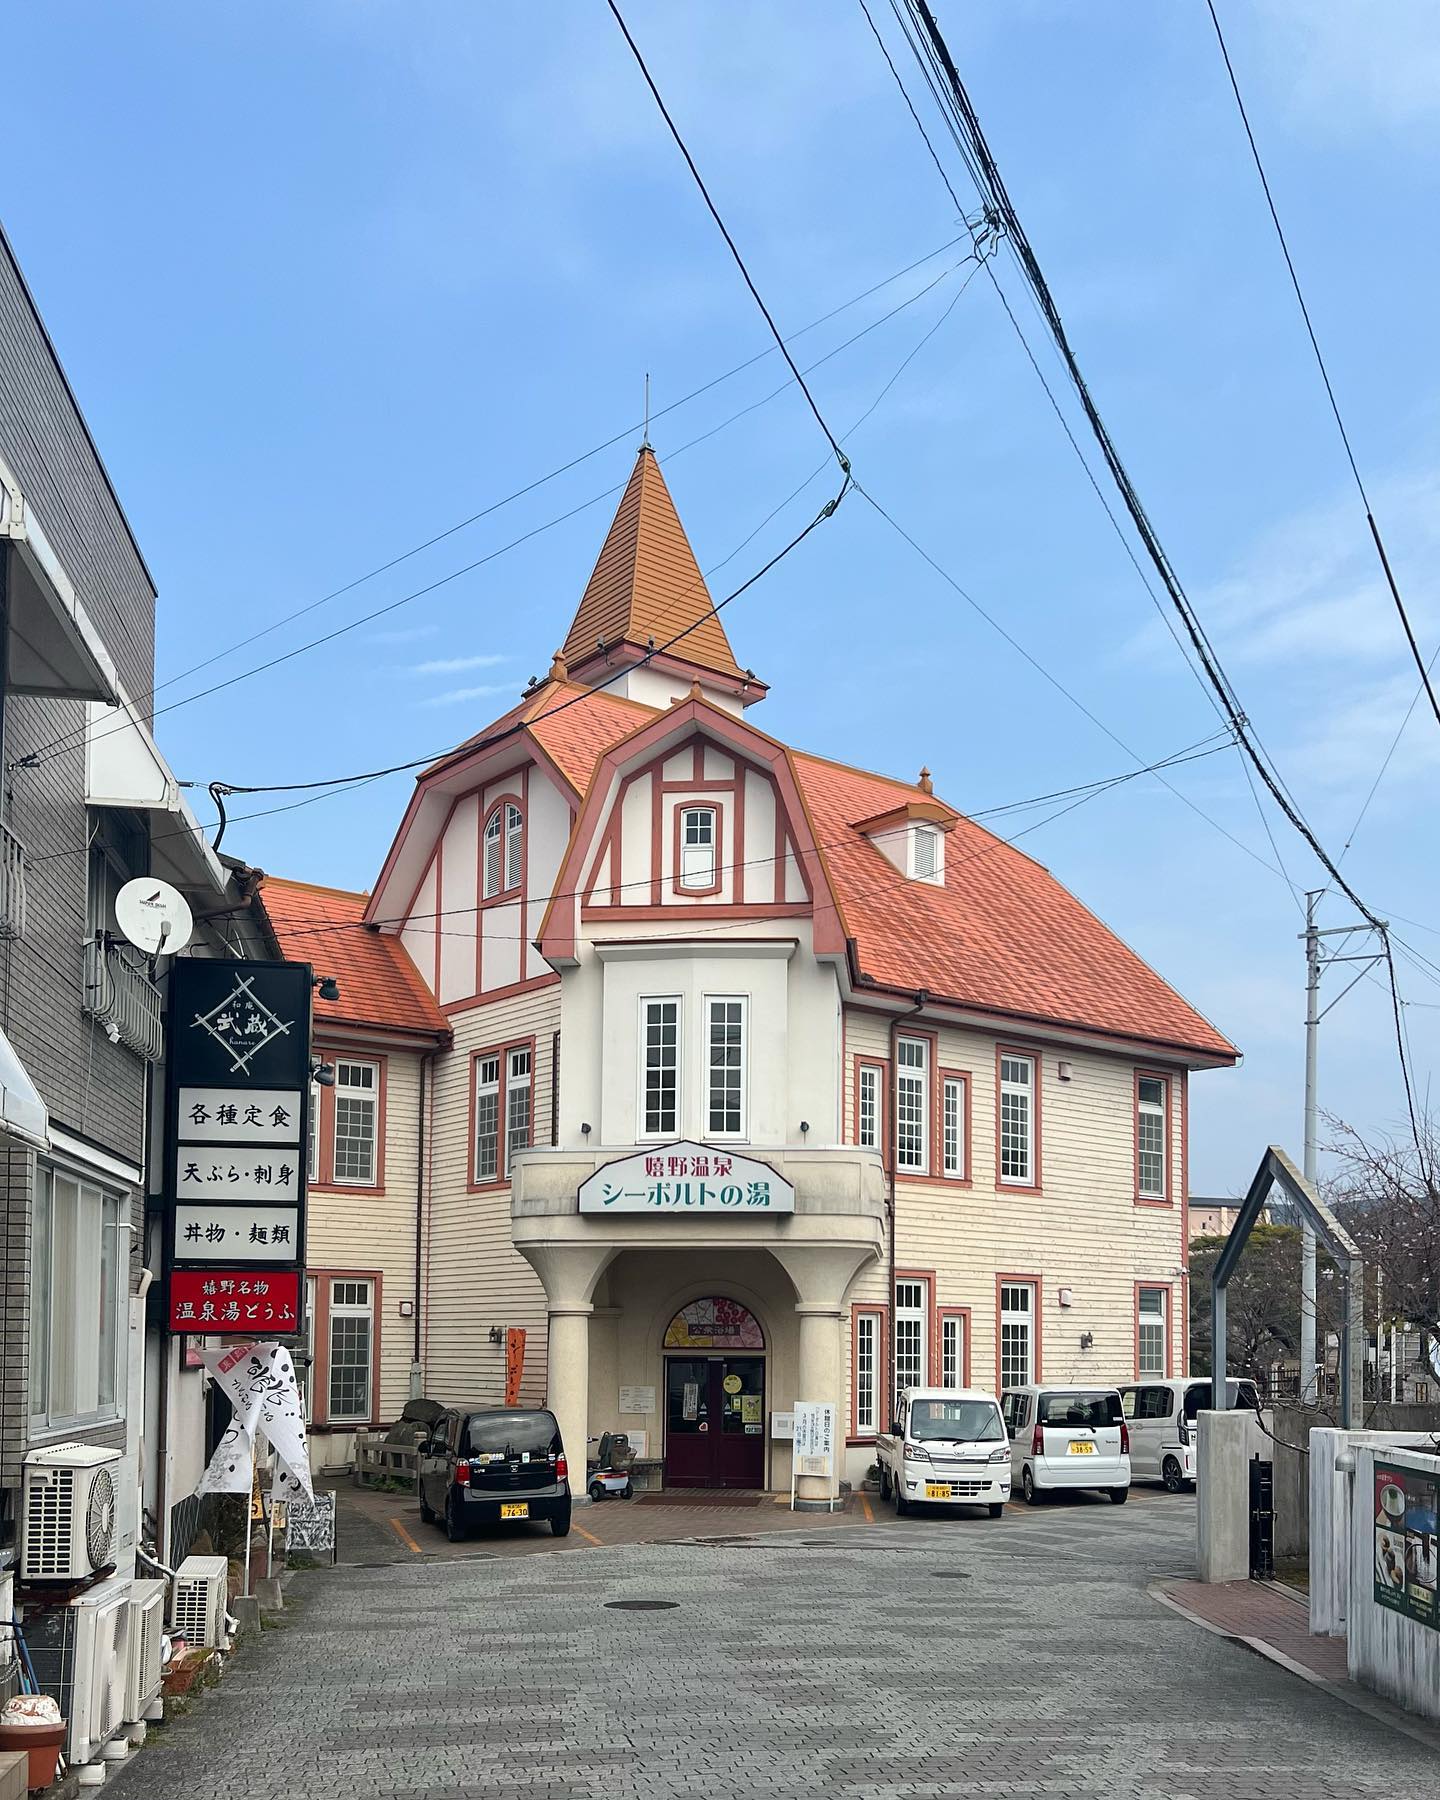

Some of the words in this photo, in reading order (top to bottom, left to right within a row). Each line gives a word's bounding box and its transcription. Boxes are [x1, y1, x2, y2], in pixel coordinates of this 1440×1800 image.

[216, 1011, 268, 1037] 武蔵
[229, 1036, 256, 1046] hanare
[188, 1103, 291, 1128] 各種定食
[182, 1162, 294, 1186] 天ぷら・刺身
[643, 1156, 733, 1178] 嬉野温泉
[602, 1181, 770, 1207] シーボルトの湯
[184, 1222, 290, 1245] 丼物・麺類
[202, 1279, 270, 1296] 嬉野名物
[176, 1300, 295, 1322] 温泉湯どうふ
[506, 1508, 528, 1517] 76-30
